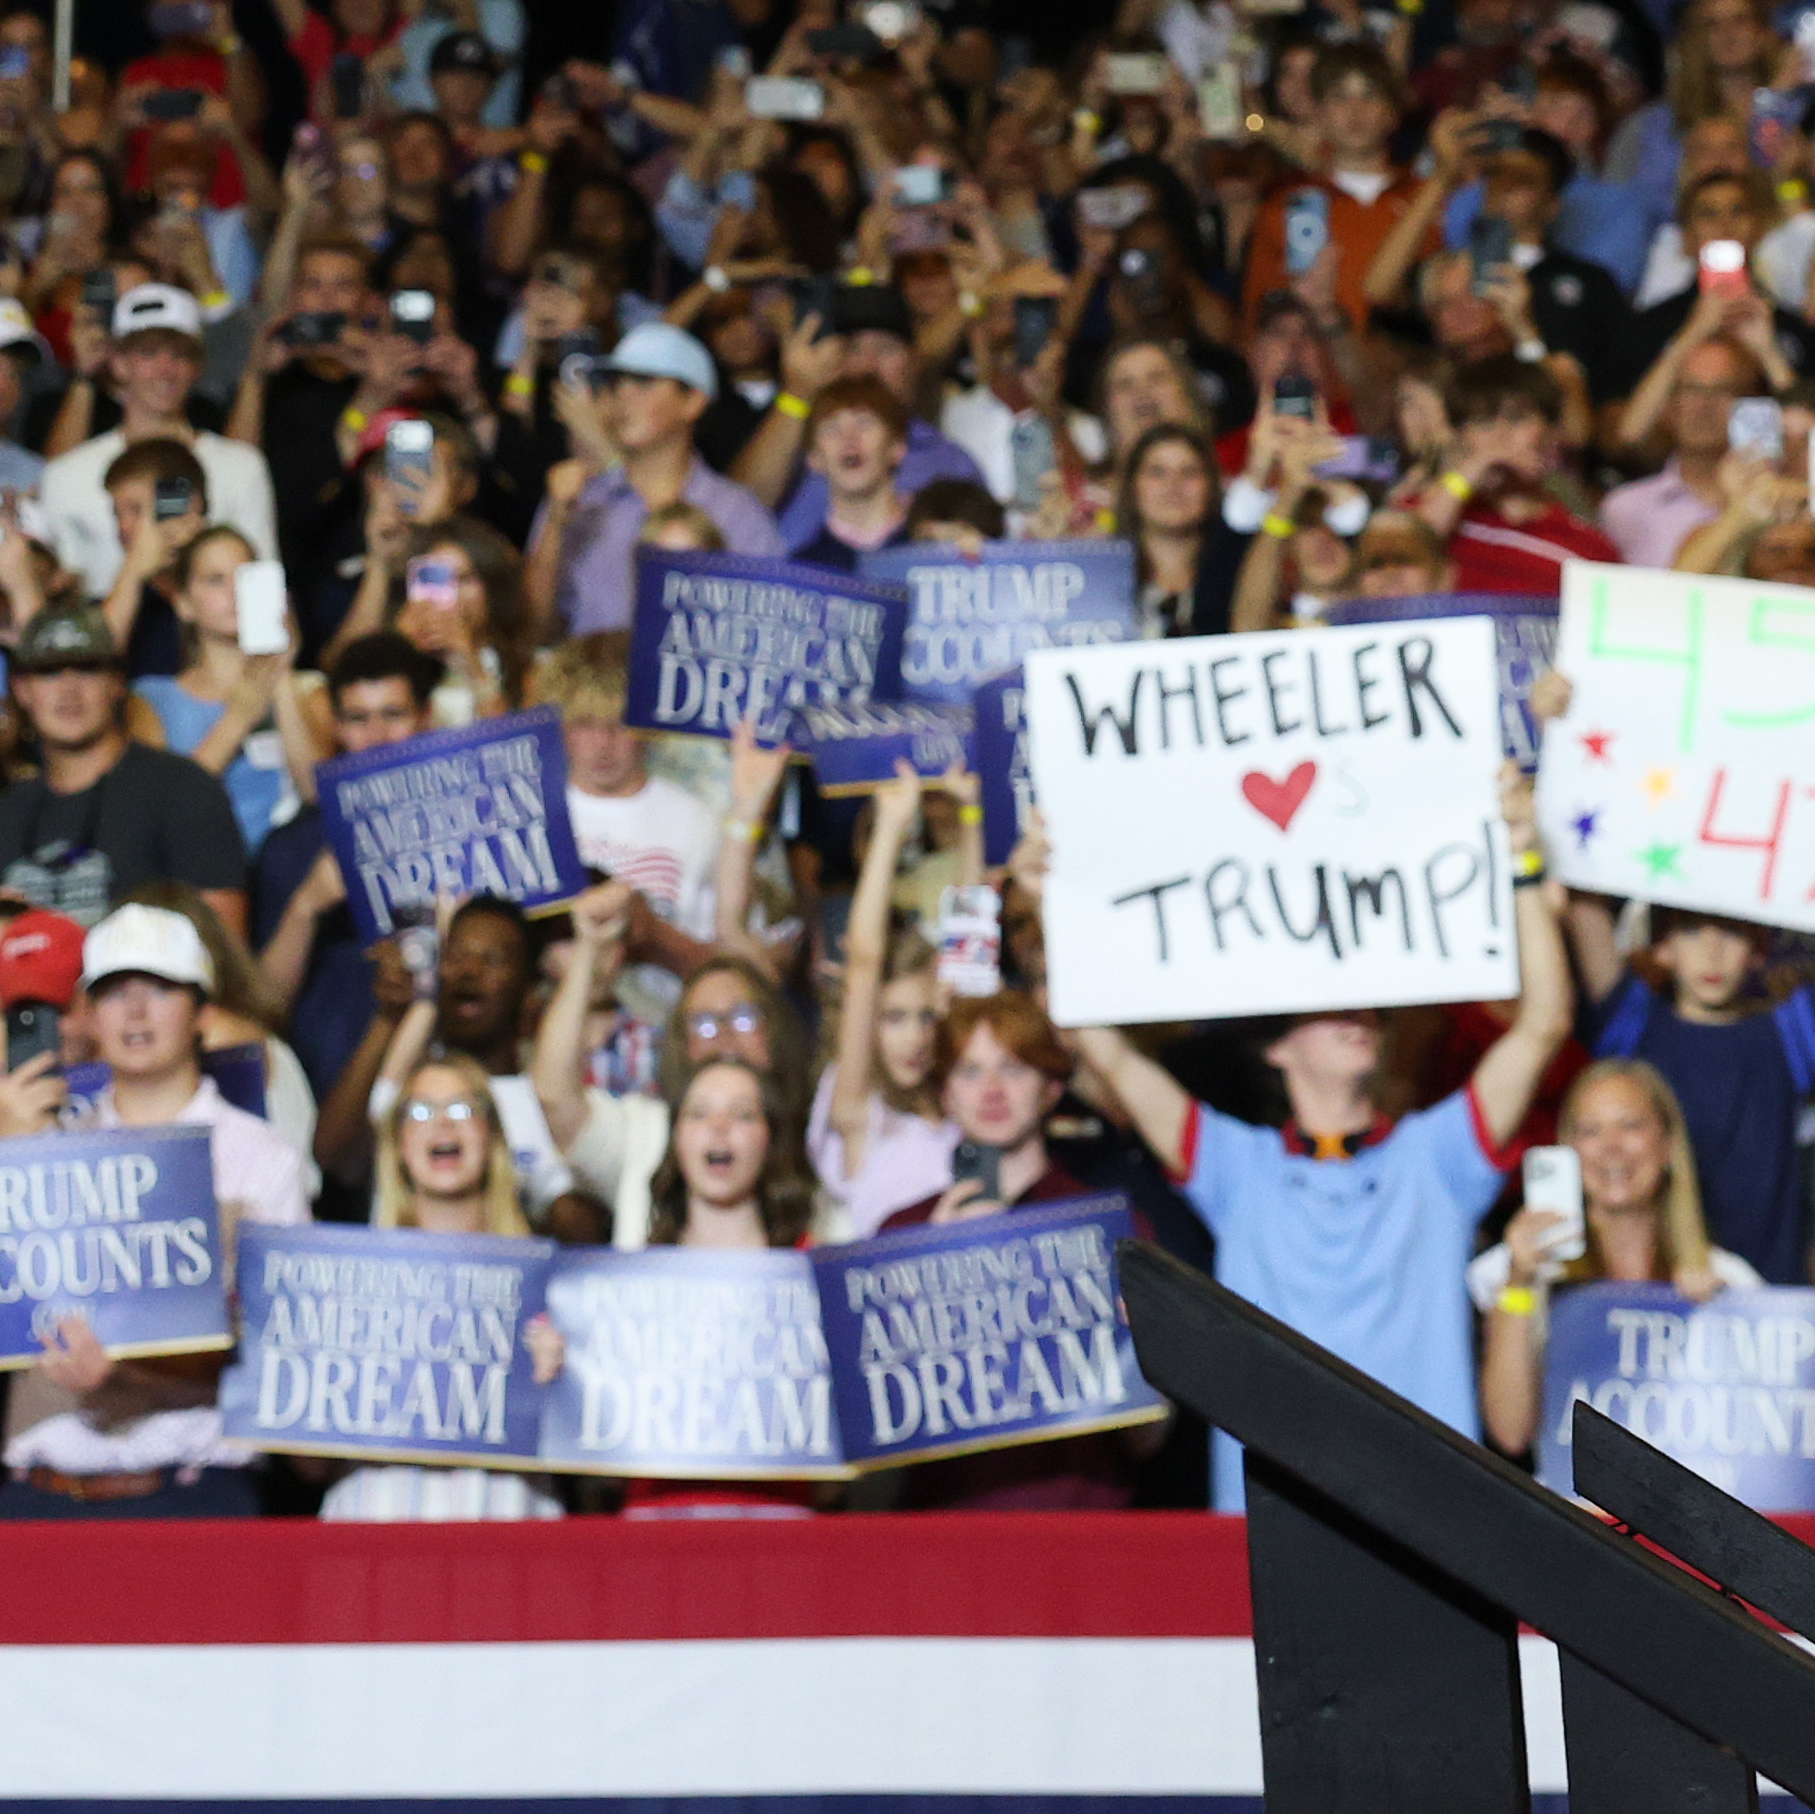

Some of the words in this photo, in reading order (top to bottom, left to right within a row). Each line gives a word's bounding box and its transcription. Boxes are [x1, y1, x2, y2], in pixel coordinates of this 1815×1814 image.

[905, 561, 1086, 626] TRUMP
[658, 606, 885, 687] AMERICAN
[1064, 634, 1465, 757] WHEELER
[1111, 819, 1502, 964] TRUMP!
[264, 1249, 448, 1299] POWERING
[453, 1262, 525, 1310] THE
[845, 1238, 1037, 1314] POWERING
[1031, 1223, 1108, 1278] THE
[262, 1289, 522, 1368] AMERICAN
[586, 1318, 832, 1381] AMERICAN
[860, 1266, 1115, 1368] AMERICAN
[255, 1346, 510, 1445] DREAM
[578, 1368, 833, 1457] DREAM
[865, 1321, 1126, 1446] DREAM
